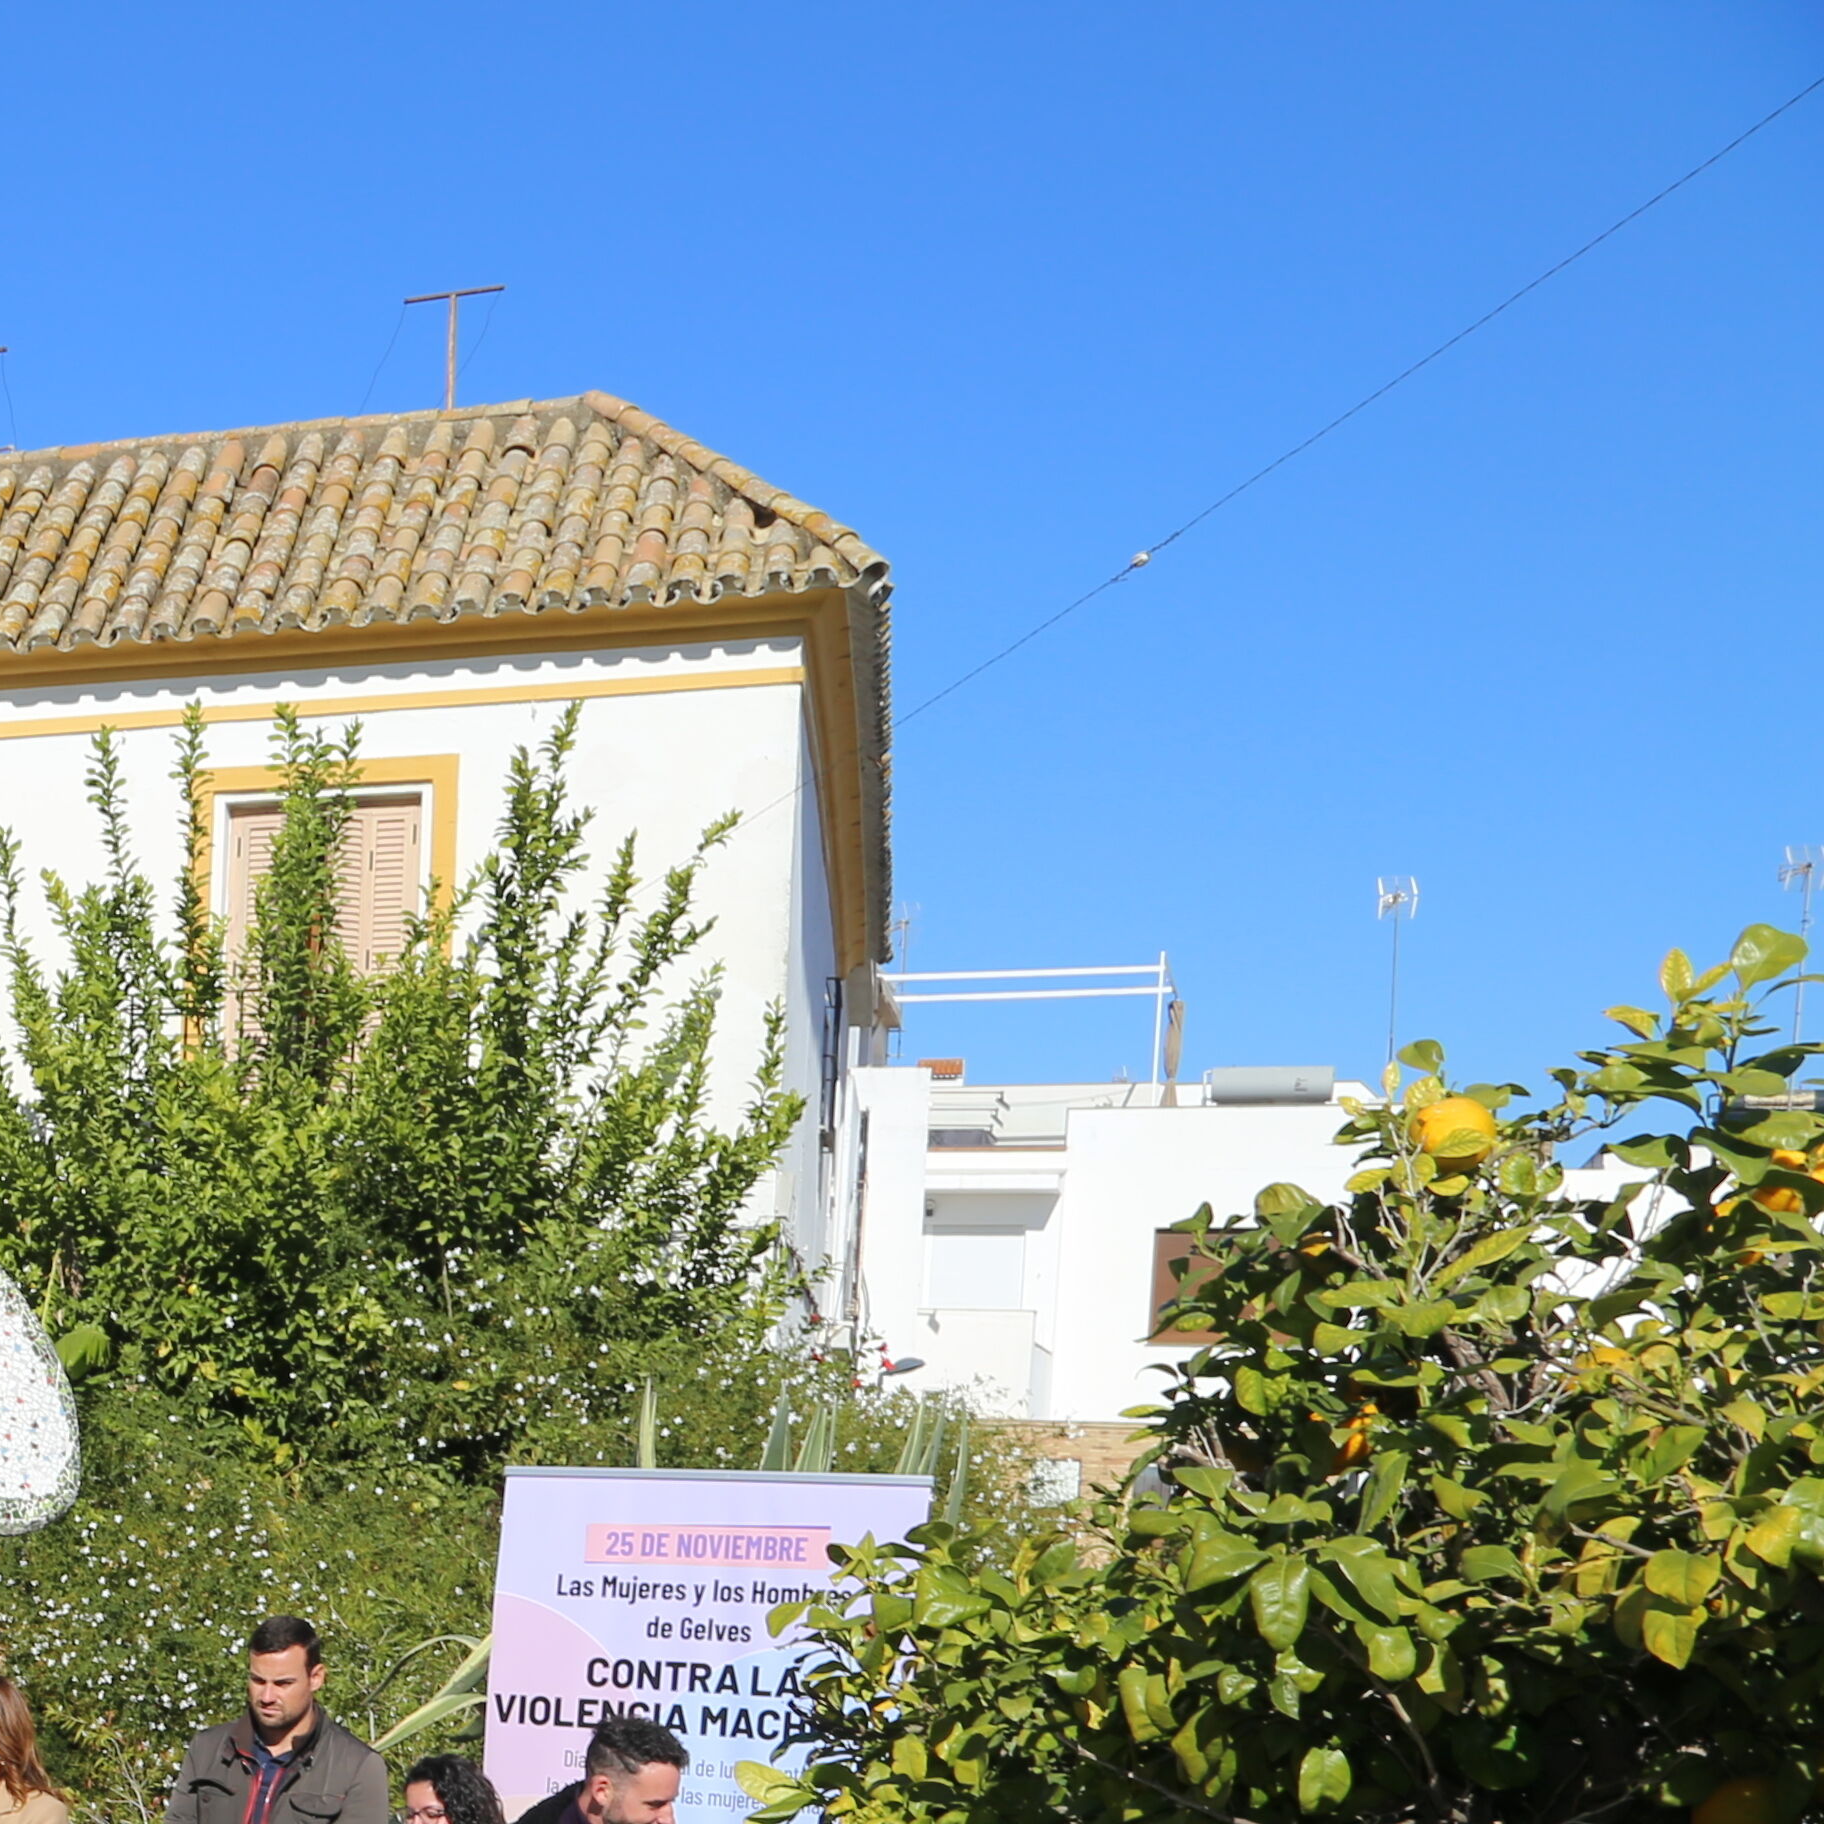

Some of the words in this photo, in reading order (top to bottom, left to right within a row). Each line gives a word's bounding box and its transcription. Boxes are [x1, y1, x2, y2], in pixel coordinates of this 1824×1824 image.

[605, 1531, 635, 1557] 25
[640, 1532, 671, 1558] DE
[676, 1533, 809, 1562] NOVIEMBRE
[556, 1574, 594, 1598] Las
[601, 1575, 687, 1605] Mujeres
[693, 1583, 707, 1607] y
[713, 1579, 745, 1603] los
[646, 1616, 673, 1639] de
[679, 1617, 752, 1643] Gelves
[586, 1657, 741, 1696] CONTRA
[750, 1665, 804, 1698] LA
[695, 1759, 715, 1778] de
[546, 1776, 560, 1794] la
[681, 1787, 703, 1805] las
